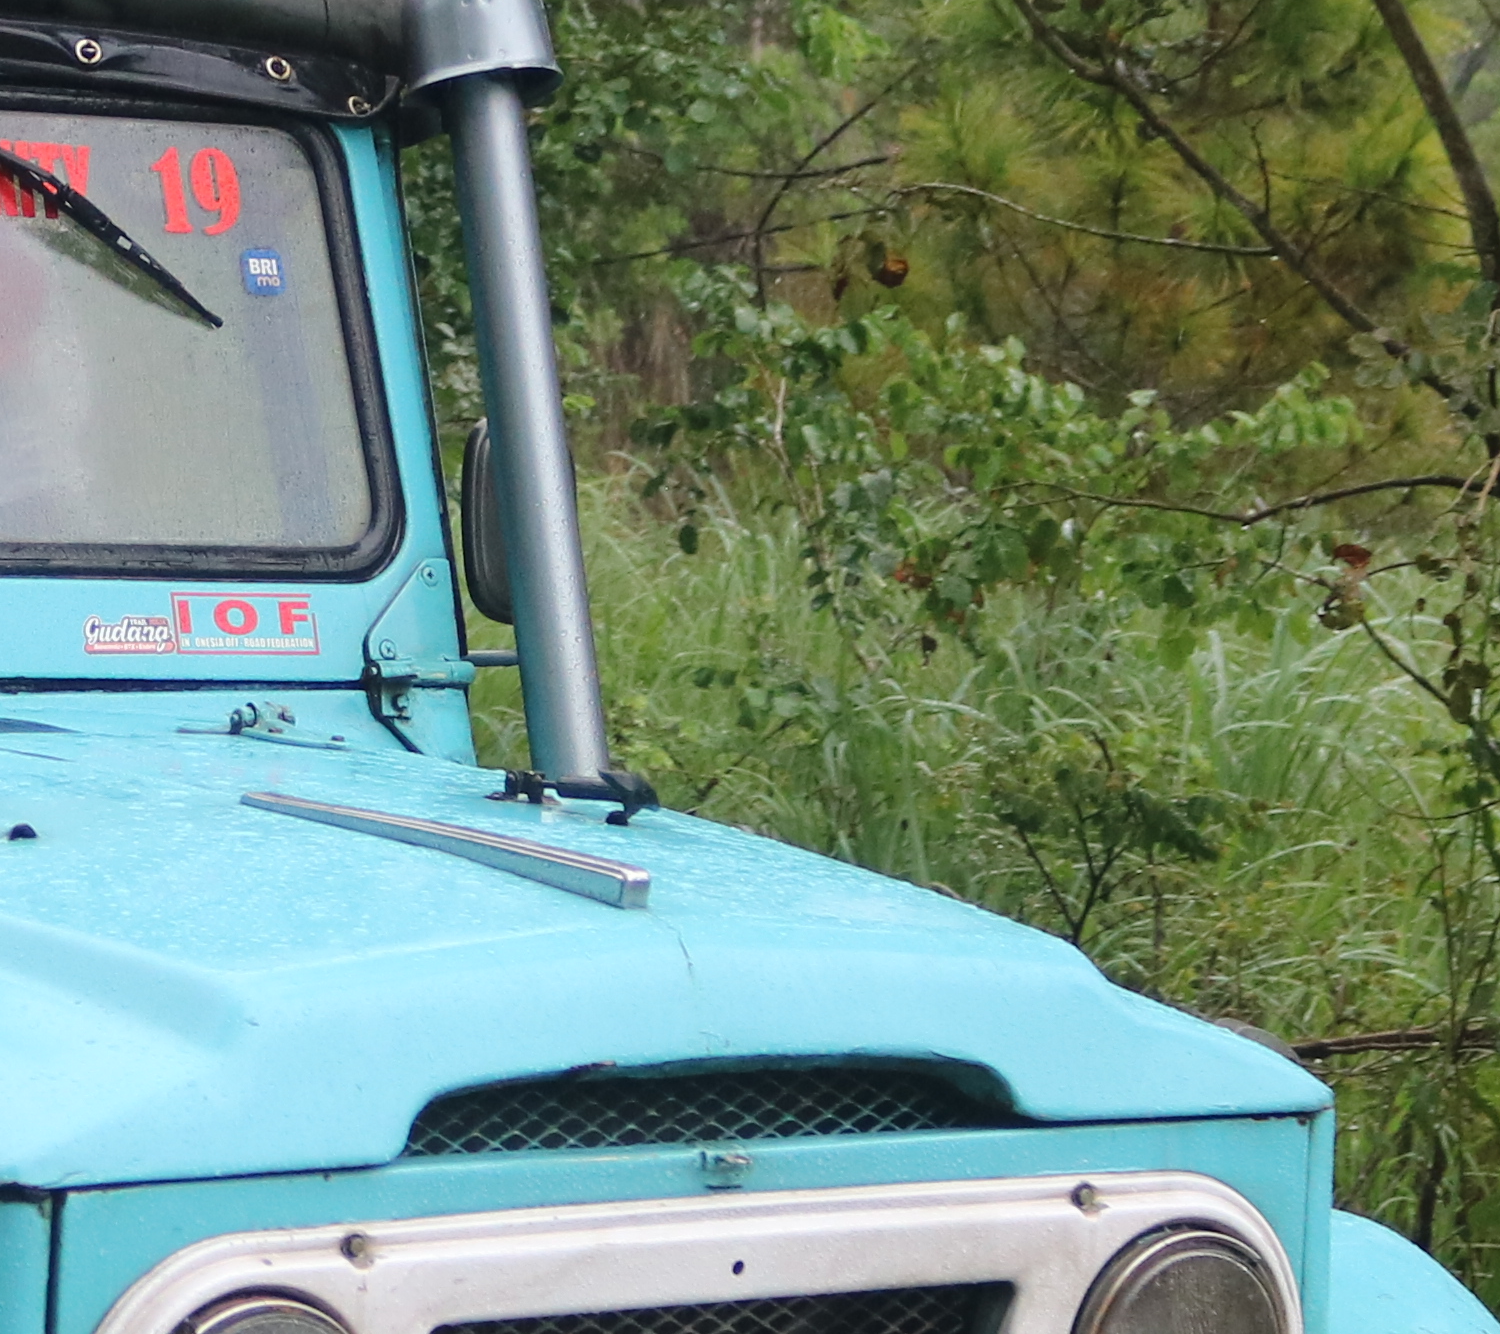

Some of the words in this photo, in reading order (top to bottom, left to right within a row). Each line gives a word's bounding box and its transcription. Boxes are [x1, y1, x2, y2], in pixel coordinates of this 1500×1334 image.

[150, 146, 241, 236] 19
[248, 258, 279, 276] BRI
[256, 276, 281, 287] mo
[85, 617, 169, 653] Gudang
[177, 599, 309, 636] IOF
